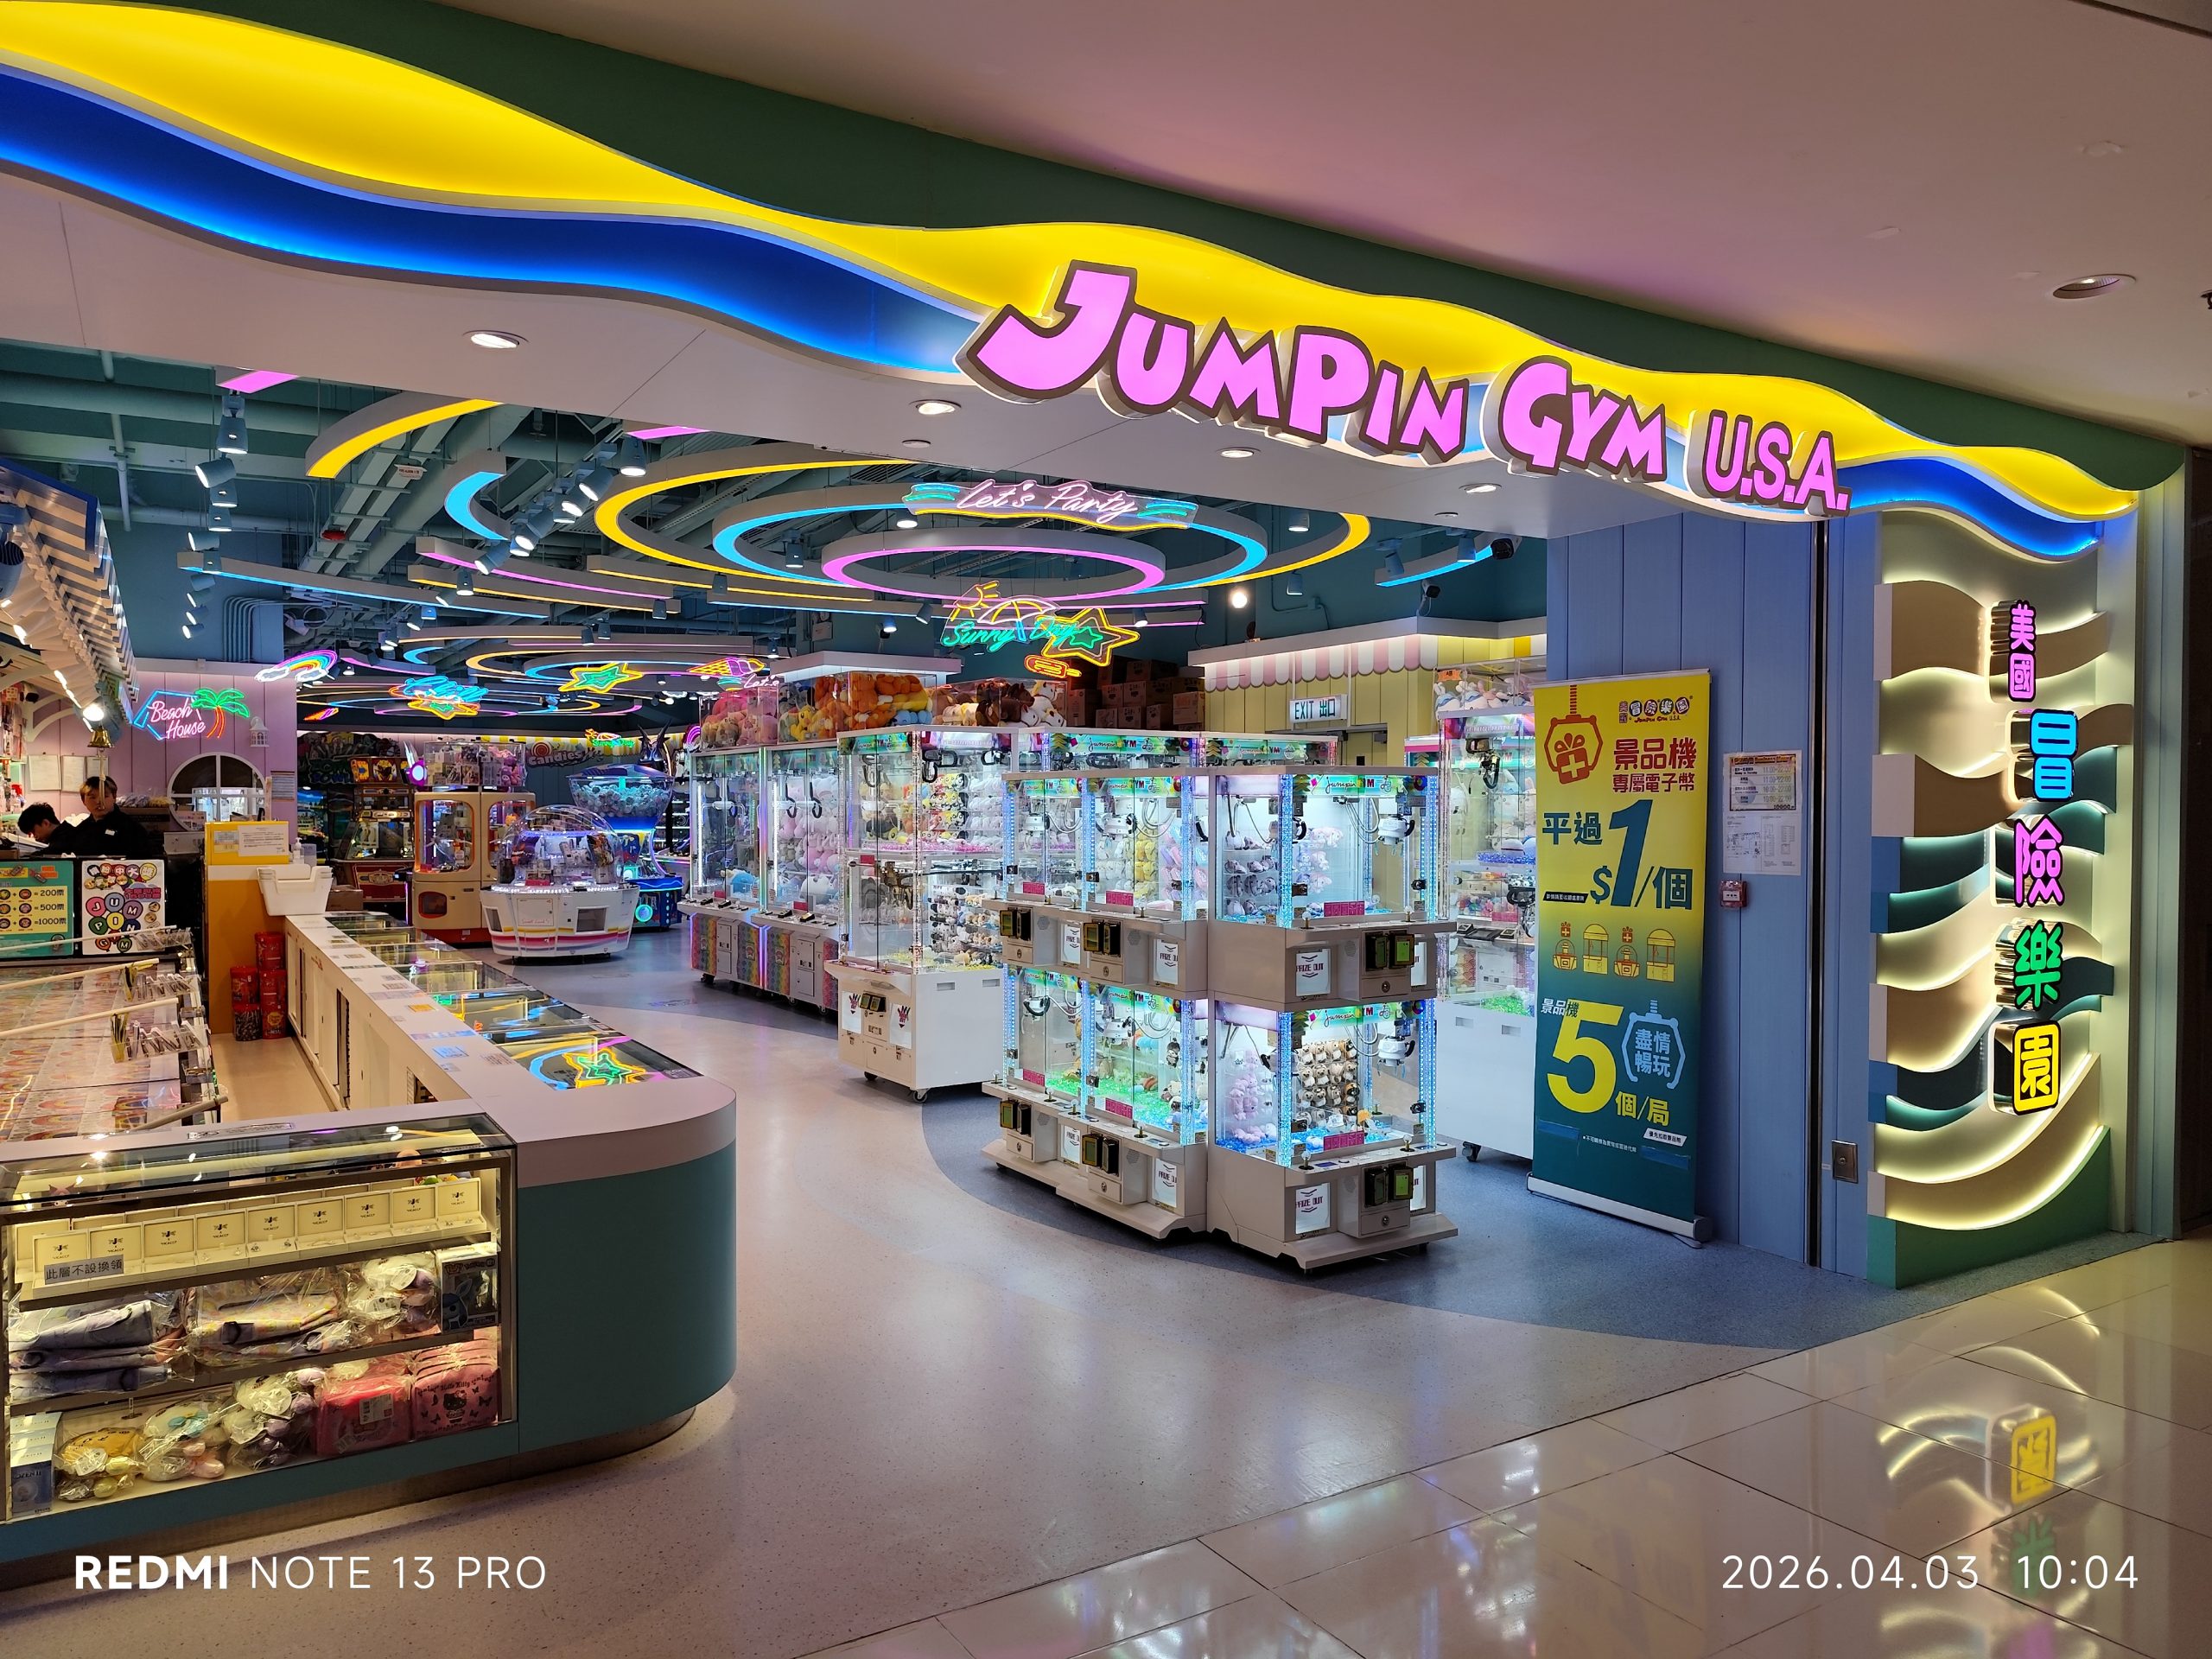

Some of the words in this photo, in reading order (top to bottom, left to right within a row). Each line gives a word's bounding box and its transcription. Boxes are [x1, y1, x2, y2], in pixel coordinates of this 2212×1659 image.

[1497, 354, 1668, 481] GYM
[957, 479, 1036, 510] Let's
[1043, 480, 1140, 524] Party
[943, 620, 1018, 653] Sunny
[1028, 615, 1080, 648] Day
[146, 696, 193, 723] Beach
[1294, 700, 1314, 720] EXIT
[1319, 698, 1336, 718] 出口
[166, 719, 207, 740] House
[528, 750, 582, 766] candies
[1613, 737, 1697, 771] 景品機
[1612, 772, 1695, 793] 專屬電子幣
[1541, 811, 1603, 846] 平過
[1541, 998, 1580, 1019] 景品機
[1635, 1028, 1671, 1055] 盡情
[1634, 1051, 1671, 1078] 暢玩
[46, 1259, 123, 1280] 此層不設換領
